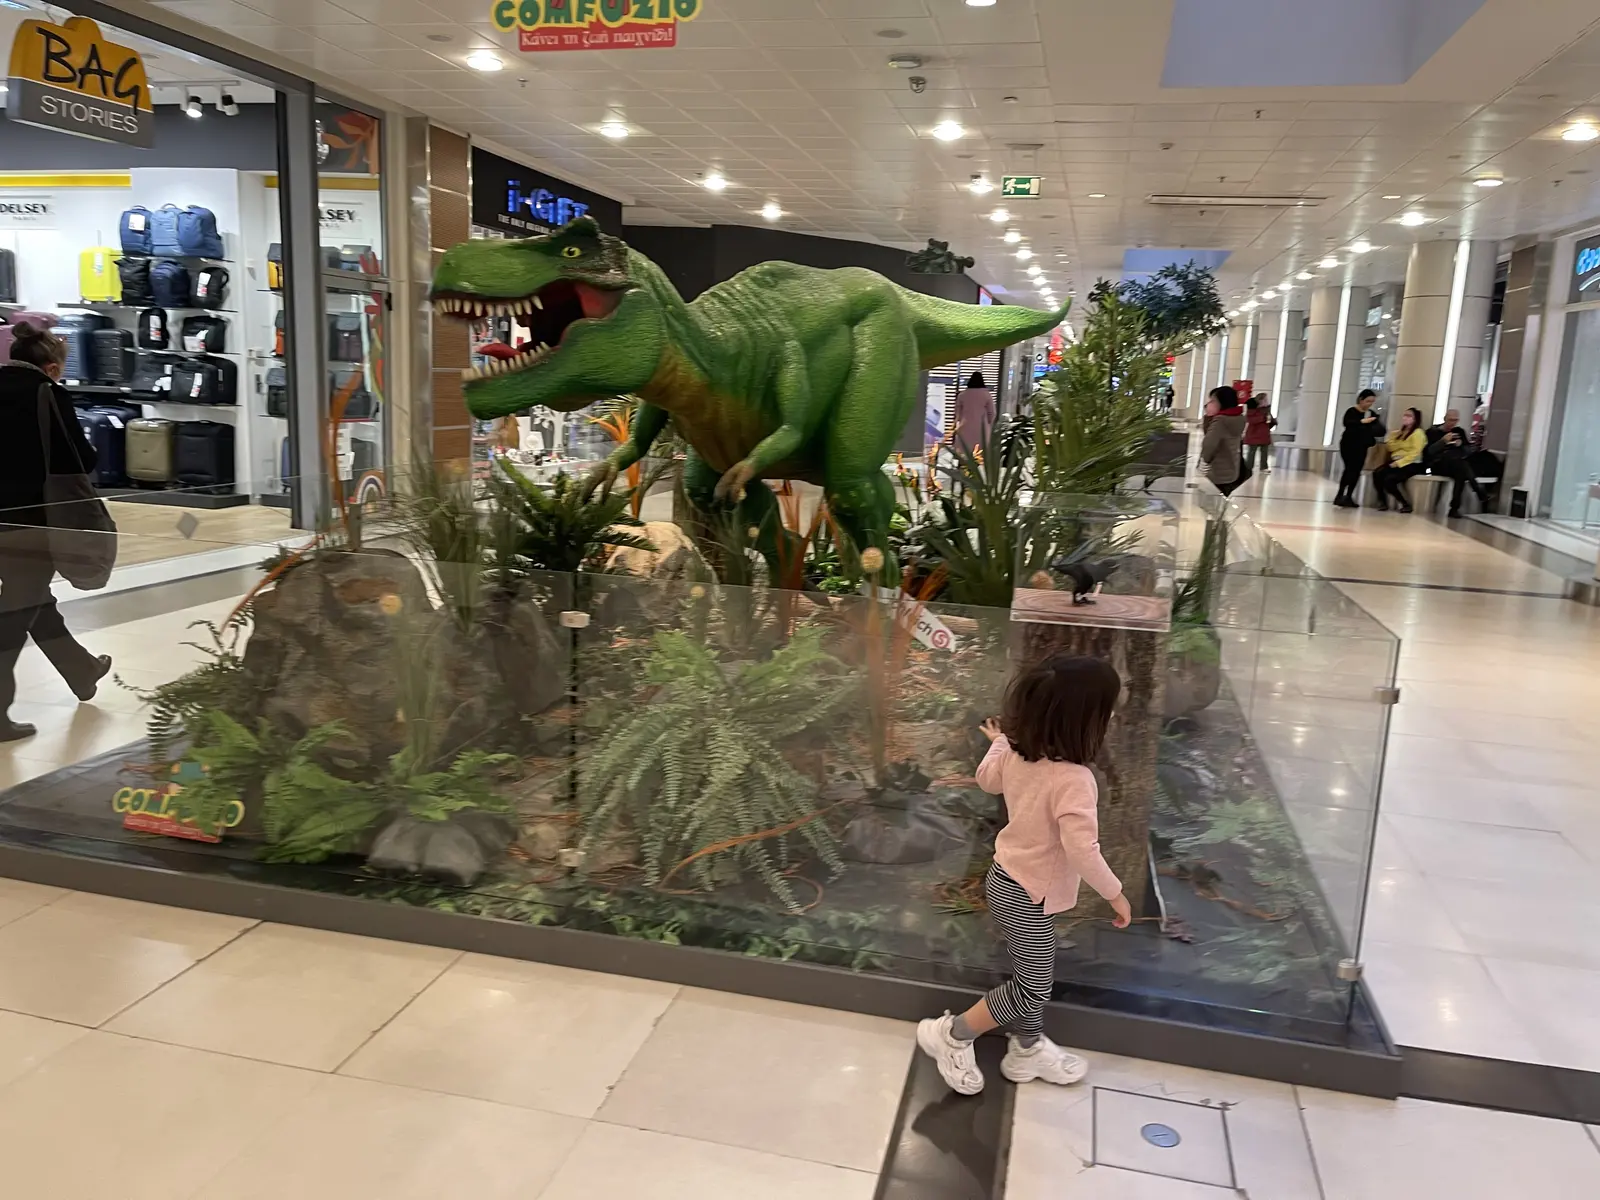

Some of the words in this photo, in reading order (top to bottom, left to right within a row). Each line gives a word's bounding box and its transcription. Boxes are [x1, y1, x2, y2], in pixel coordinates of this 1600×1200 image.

[36, 26, 140, 115] BAG
[40, 95, 138, 134] STORIES
[0, 203, 48, 214] DELSEY
